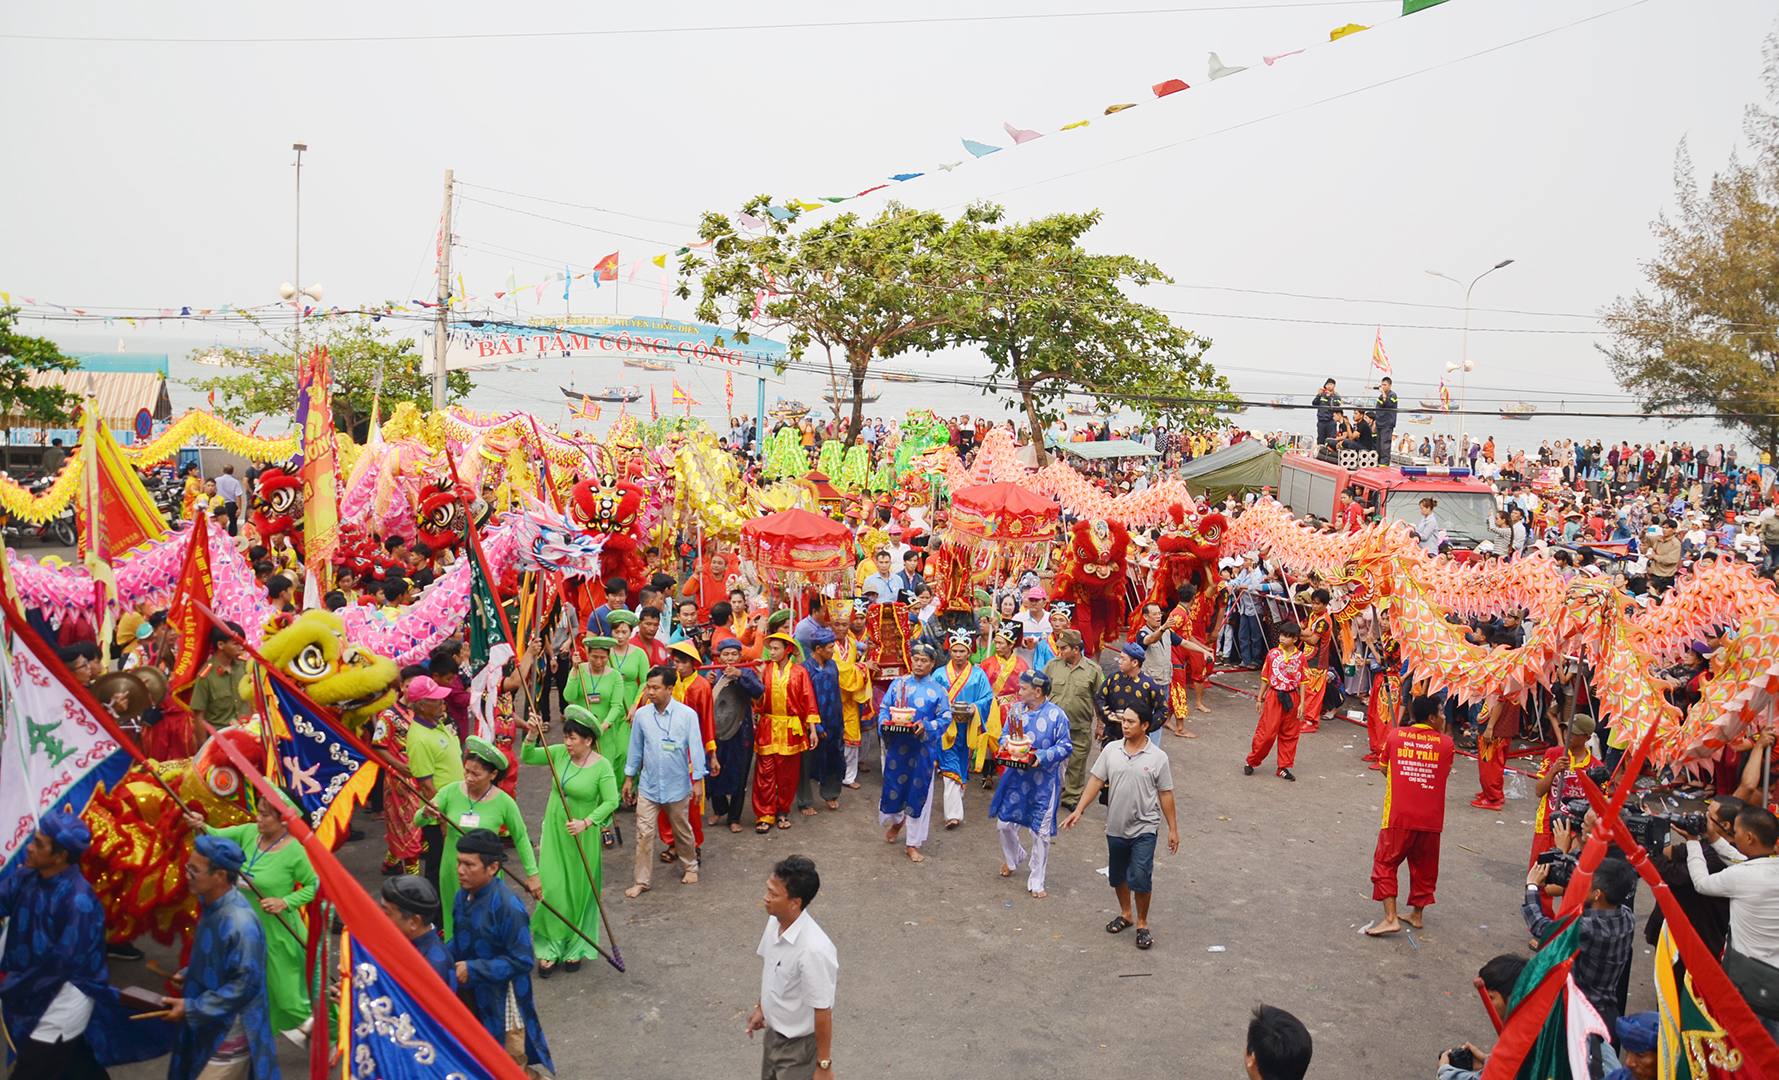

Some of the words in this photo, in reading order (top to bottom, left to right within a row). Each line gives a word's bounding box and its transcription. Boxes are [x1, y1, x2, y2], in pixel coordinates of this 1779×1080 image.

[544, 317, 565, 326] BAN
[566, 316, 594, 326] NHÂN
[618, 318, 650, 329] HUYỆN
[651, 321, 676, 332] LONG
[477, 334, 525, 358] BÃI
[533, 326, 591, 352] TẮM
[599, 331, 669, 355] CÔNG
[677, 340, 743, 367] CỘNG
[184, 615, 197, 635] LÂN
[184, 636, 195, 651] SƯ
